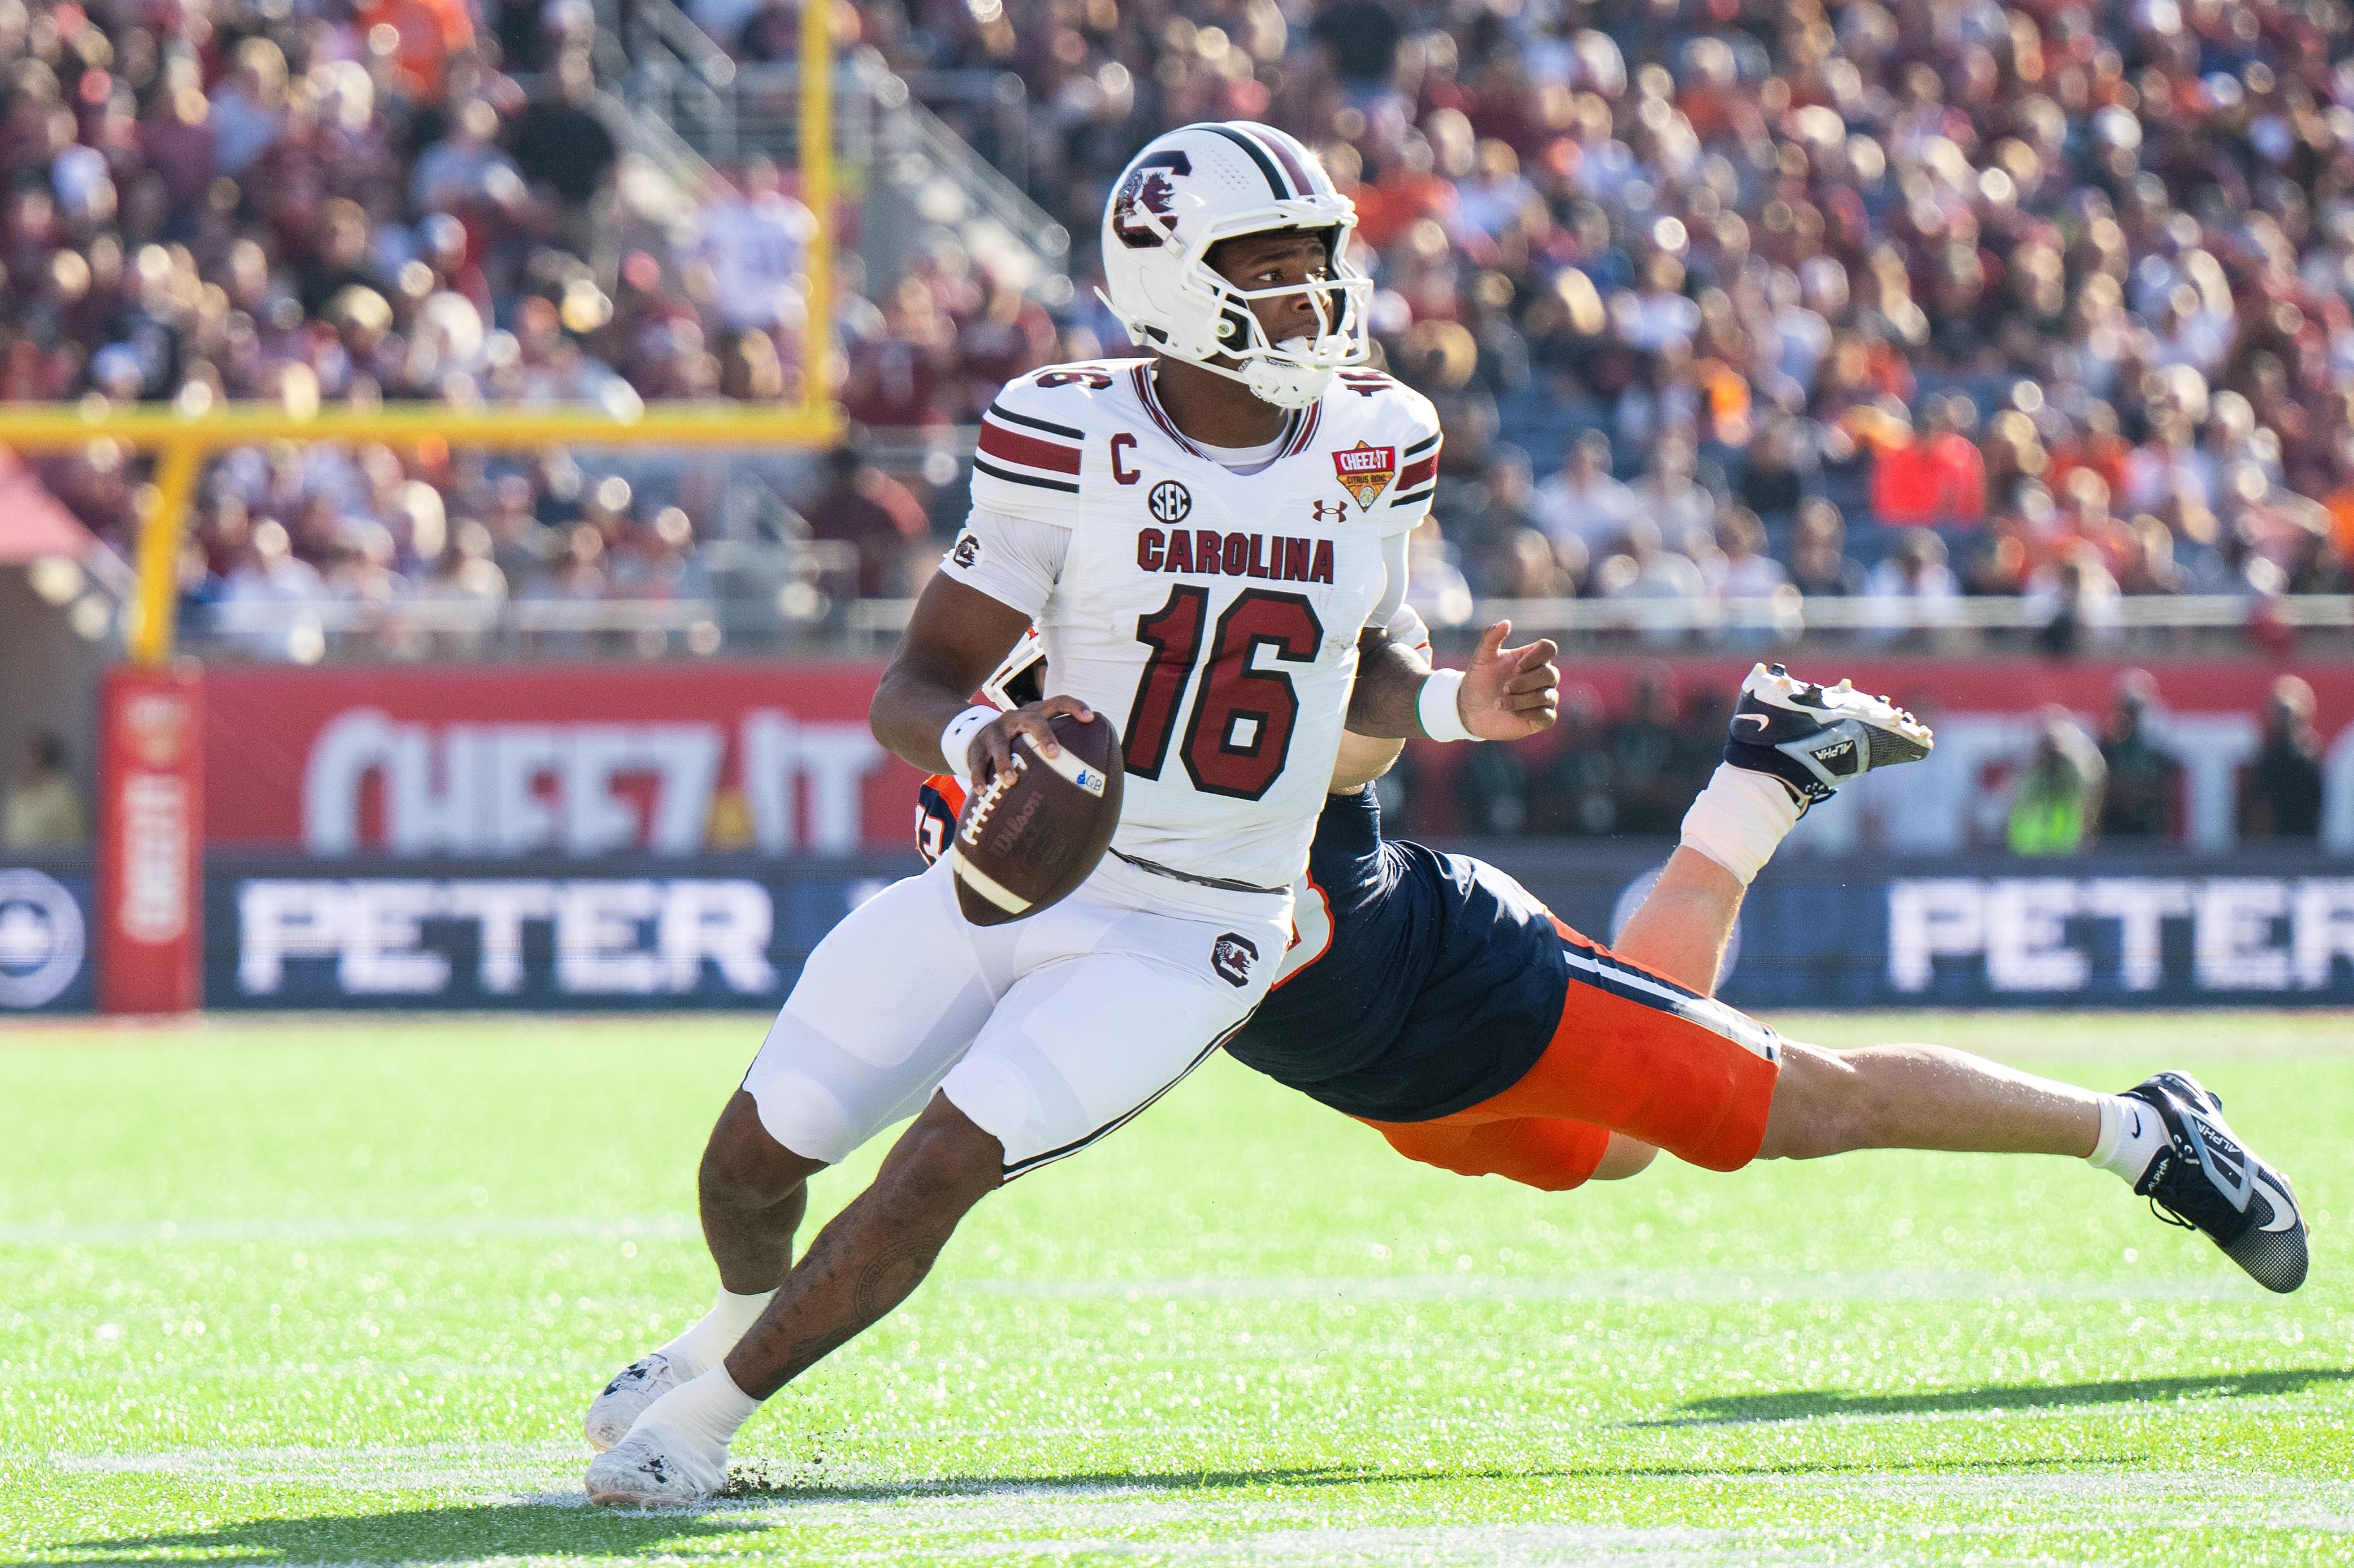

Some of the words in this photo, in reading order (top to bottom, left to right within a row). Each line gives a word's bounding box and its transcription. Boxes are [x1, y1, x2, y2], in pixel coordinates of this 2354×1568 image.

[1110, 432, 1141, 485] C
[1347, 476, 1369, 485] CITRUS
[1152, 483, 1187, 520] SEC
[1137, 528, 1333, 584] CAROLINA
[1121, 583, 1324, 802] 16
[1815, 740, 1853, 761] ALPHA
[991, 791, 1046, 856] Wilson
[238, 878, 776, 994] PETER
[2197, 1119, 2243, 1154] ALPHA
[2148, 1157, 2171, 1192] ALPHA
